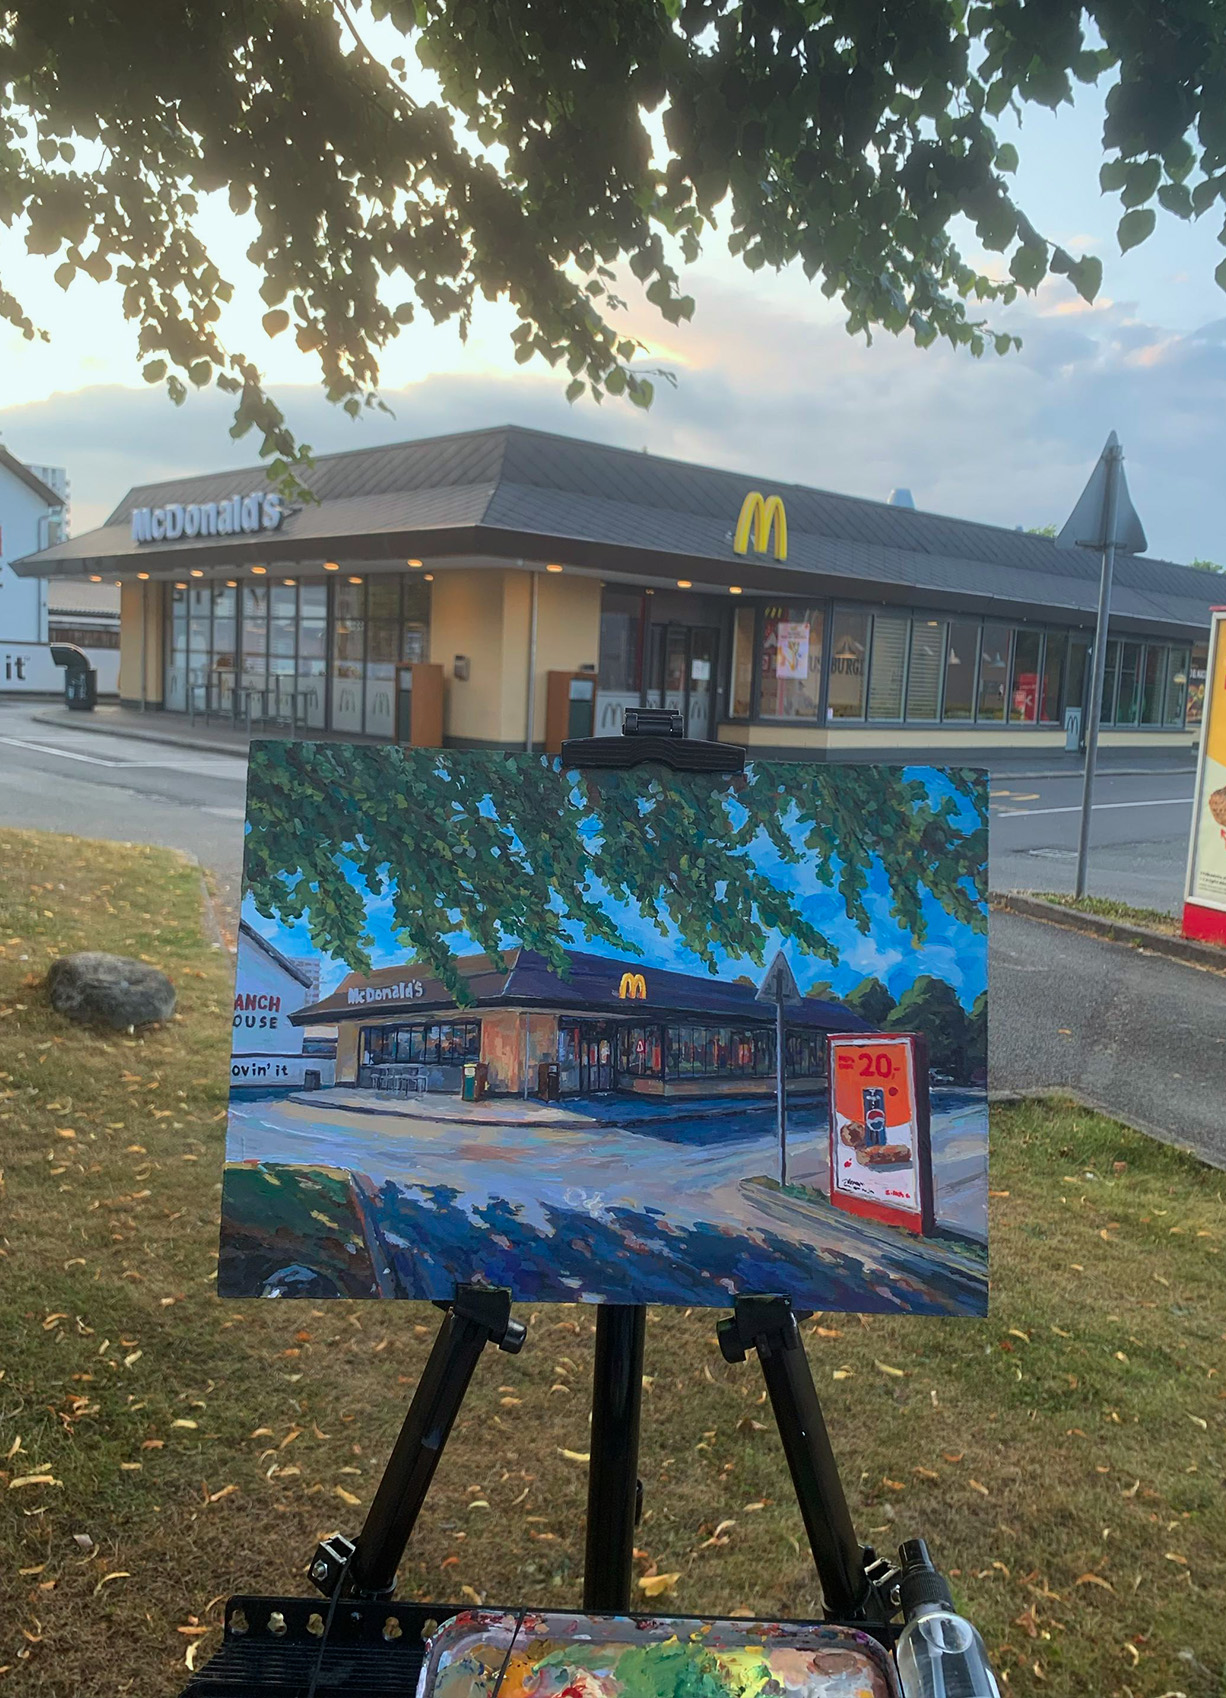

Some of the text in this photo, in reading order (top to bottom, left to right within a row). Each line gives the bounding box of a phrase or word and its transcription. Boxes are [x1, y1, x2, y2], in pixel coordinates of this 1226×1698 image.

[131, 491, 281, 541] McDonald's
[5, 655, 26, 680] it
[234, 993, 281, 1013] ANCH
[347, 979, 423, 1005] McDonald's
[232, 1014, 278, 1029] OUSE
[231, 1062, 289, 1077] ovin' it
